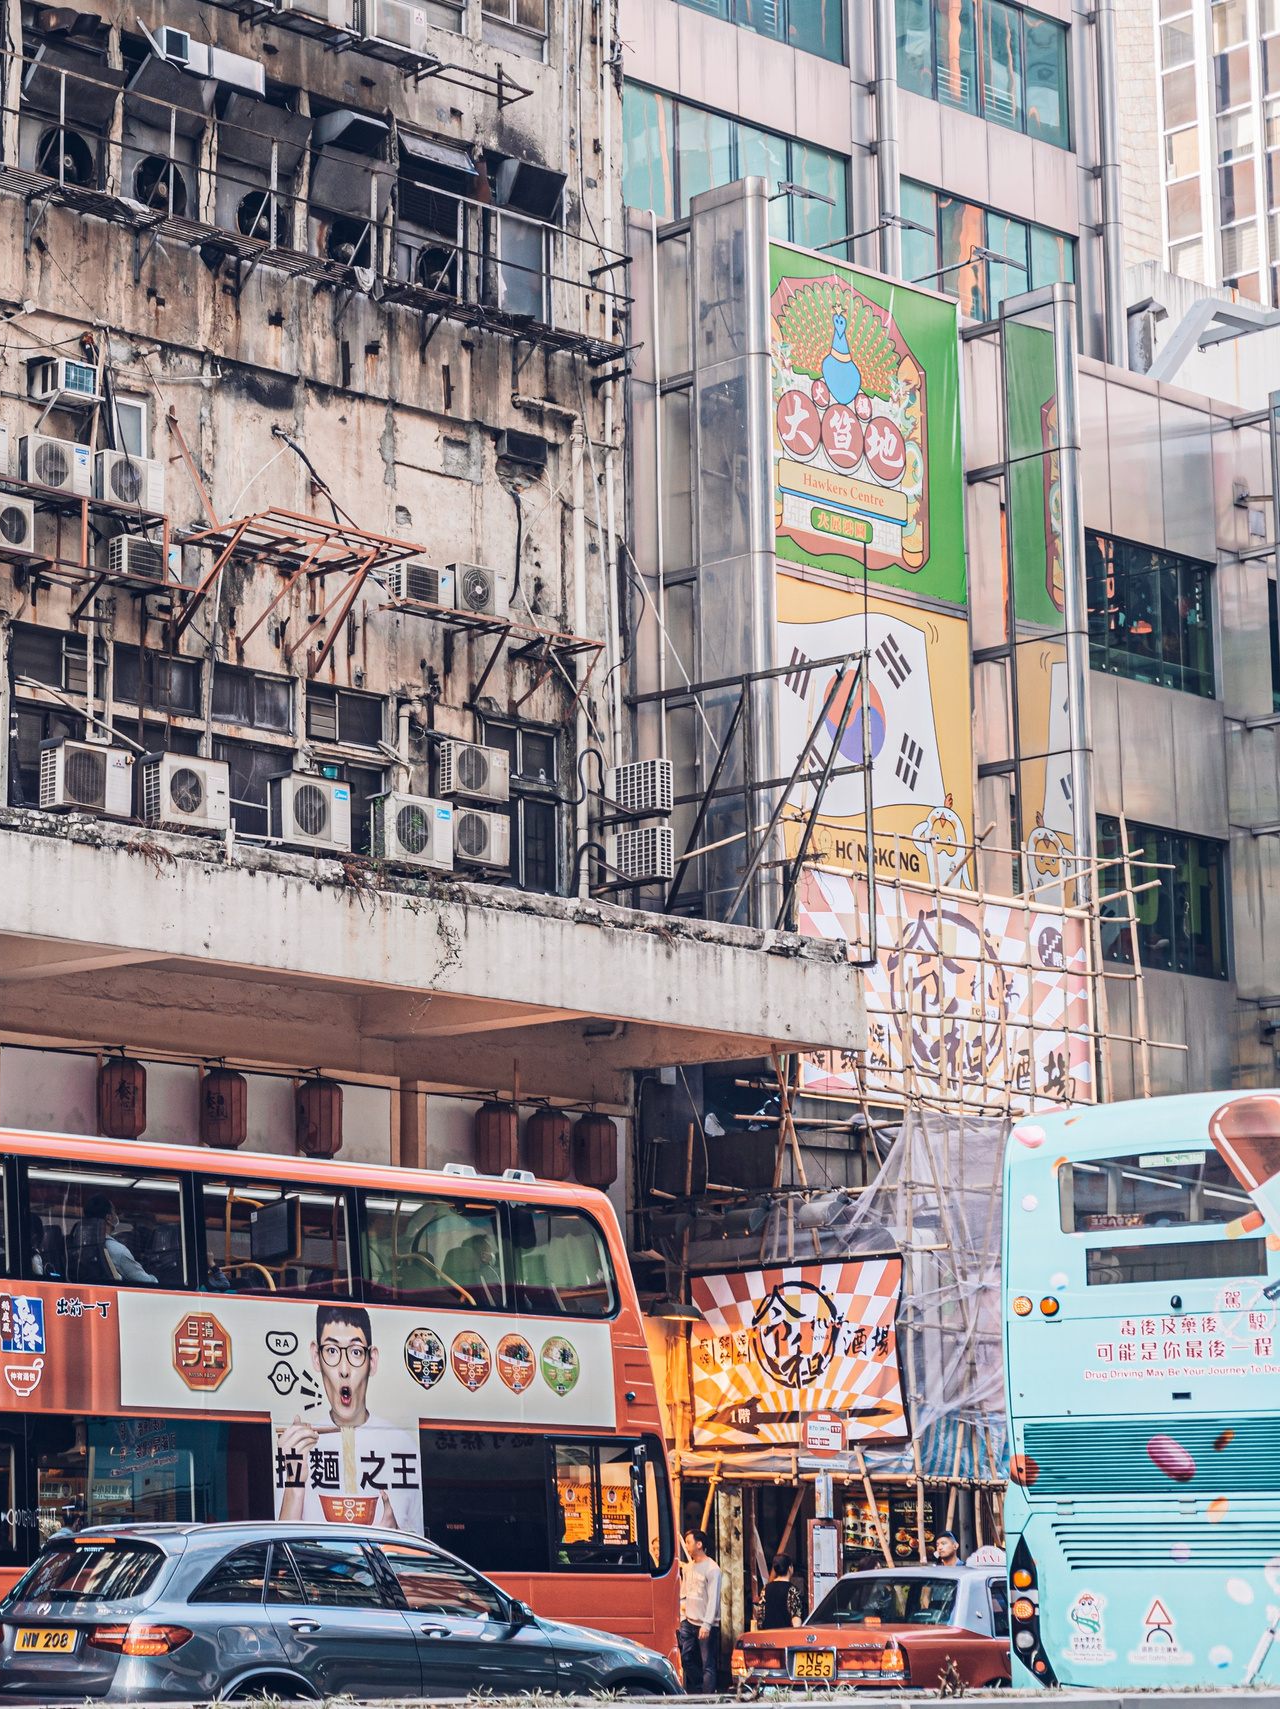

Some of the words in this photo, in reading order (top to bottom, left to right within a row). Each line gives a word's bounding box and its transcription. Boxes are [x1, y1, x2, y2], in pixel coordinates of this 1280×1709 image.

[782, 394, 904, 468] 大笪地
[803, 472, 848, 498] Hawkers
[850, 486, 885, 507] Centre
[817, 512, 867, 540] 大展鴻圖
[971, 1005, 997, 1019] rewa
[56, 1297, 111, 1319] 出前一丁
[187, 1321, 214, 1338] 日清
[1120, 1317, 1218, 1336] 毒後及藥後
[275, 1338, 290, 1348] RA
[843, 1324, 890, 1357] 酒場
[178, 1338, 225, 1369] ラ王
[1096, 1337, 1272, 1363] 可能是你最後一程
[276, 1373, 291, 1383] OH
[1085, 1370, 1108, 1381] Drug
[1110, 1369, 1144, 1380] Driving
[1146, 1368, 1166, 1378] May
[1168, 1367, 1181, 1377] Be
[1183, 1366, 1206, 1376] Your
[1208, 1365, 1247, 1377] Journey
[1250, 1365, 1262, 1374] To
[730, 1408, 751, 1425] 1階
[275, 1447, 341, 1489] 拉麵
[359, 1450, 420, 1490] 之王
[43, 1633, 68, 1649] 208
[806, 1653, 824, 1665] NC
[1131, 1654, 1147, 1663] Road
[1148, 1654, 1167, 1664] Safety
[797, 1664, 831, 1677] 2253
